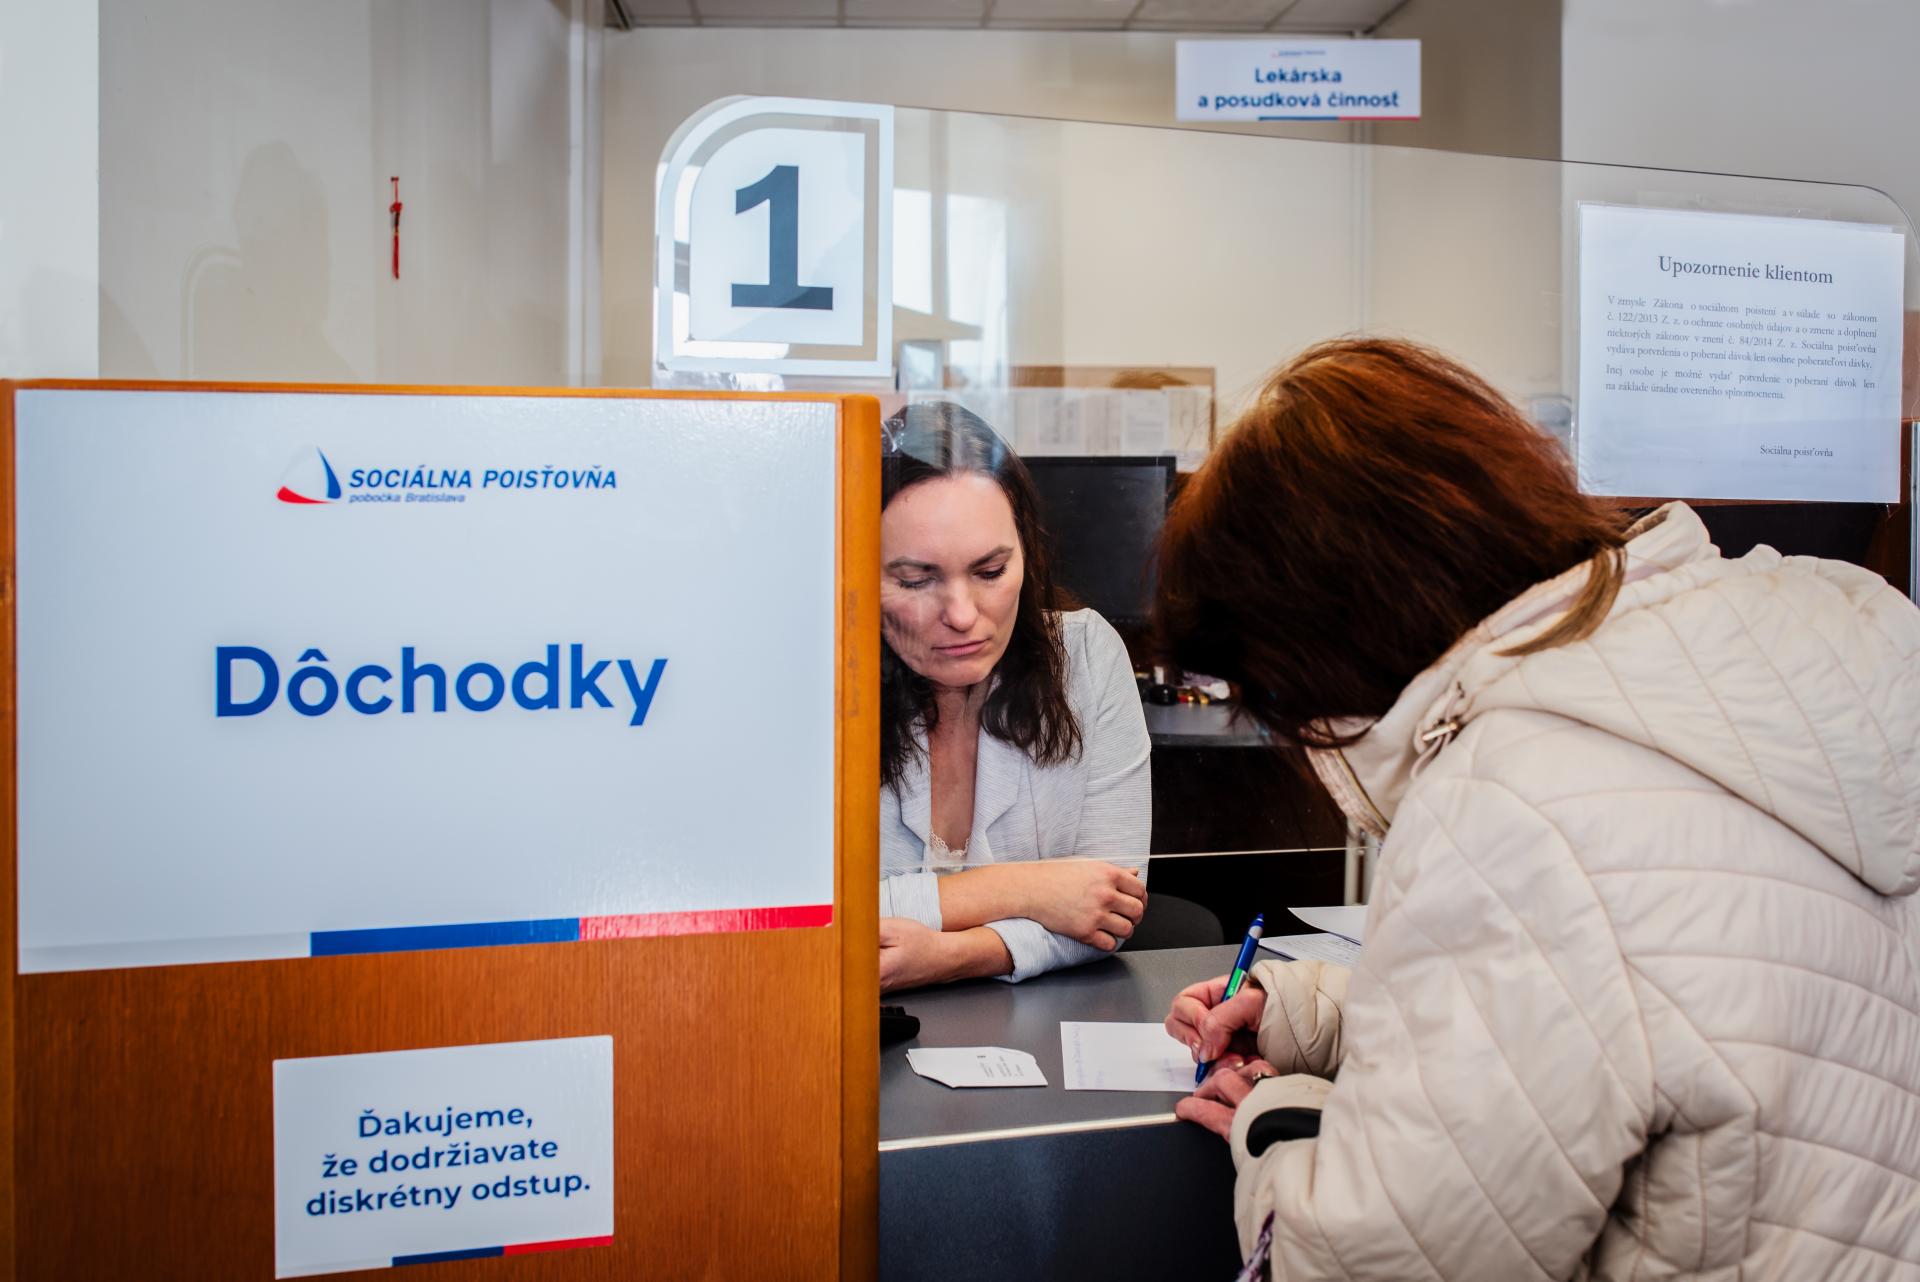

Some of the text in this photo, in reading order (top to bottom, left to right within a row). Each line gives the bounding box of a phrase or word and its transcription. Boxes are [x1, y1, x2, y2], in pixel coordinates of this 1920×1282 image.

[1255, 67, 1342, 83] Lekárska
[1198, 95, 1208, 107] a
[1215, 92, 1321, 110] posudková
[731, 165, 834, 311] 1
[1658, 255, 1833, 284] Upozornenie klientom
[1608, 295, 1615, 304] V
[1617, 297, 1646, 309] zmysle
[1699, 303, 1739, 313] sociálnom
[1842, 311, 1877, 323] zákonom
[1618, 312, 1658, 323] 122/2013
[1691, 317, 1723, 328] ochrane
[1726, 319, 1764, 332] osobných
[1809, 328, 1835, 336] zmene
[1843, 327, 1877, 340] doplnení
[1606, 344, 1635, 357] vydáva
[1637, 346, 1681, 358] potvrdenia
[1691, 348, 1727, 361] poberaní
[1728, 350, 1750, 361] dávok
[1754, 352, 1766, 362] len
[1607, 328, 1651, 340] niektorých
[1656, 331, 1690, 341] zákonov
[1801, 339, 1833, 351] Sociálna
[1837, 342, 1876, 355] poisťovňa
[1605, 382, 1616, 390] na
[1618, 381, 1649, 392] základe
[1651, 382, 1678, 394] úradne
[1680, 386, 1723, 396] overeného
[1606, 364, 1623, 376] Inej
[1629, 366, 1654, 376] osobe
[1675, 369, 1703, 379] možné
[1739, 374, 1781, 385] potvrdenie
[1794, 376, 1829, 387] poberaní
[1834, 377, 1857, 388] dávok
[1863, 379, 1875, 389] len
[1760, 444, 1833, 459] Sociálna poisťovňa
[349, 463, 617, 489] SOCIÁLNA POISŤOVŇA
[348, 492, 466, 504] pobočka Bratislava
[216, 643, 668, 727] Dôchodky
[358, 1106, 533, 1138] Ďakujeme,
[322, 1138, 558, 1178] že dodržiavate
[306, 1171, 591, 1217] diskrétny odstup.
